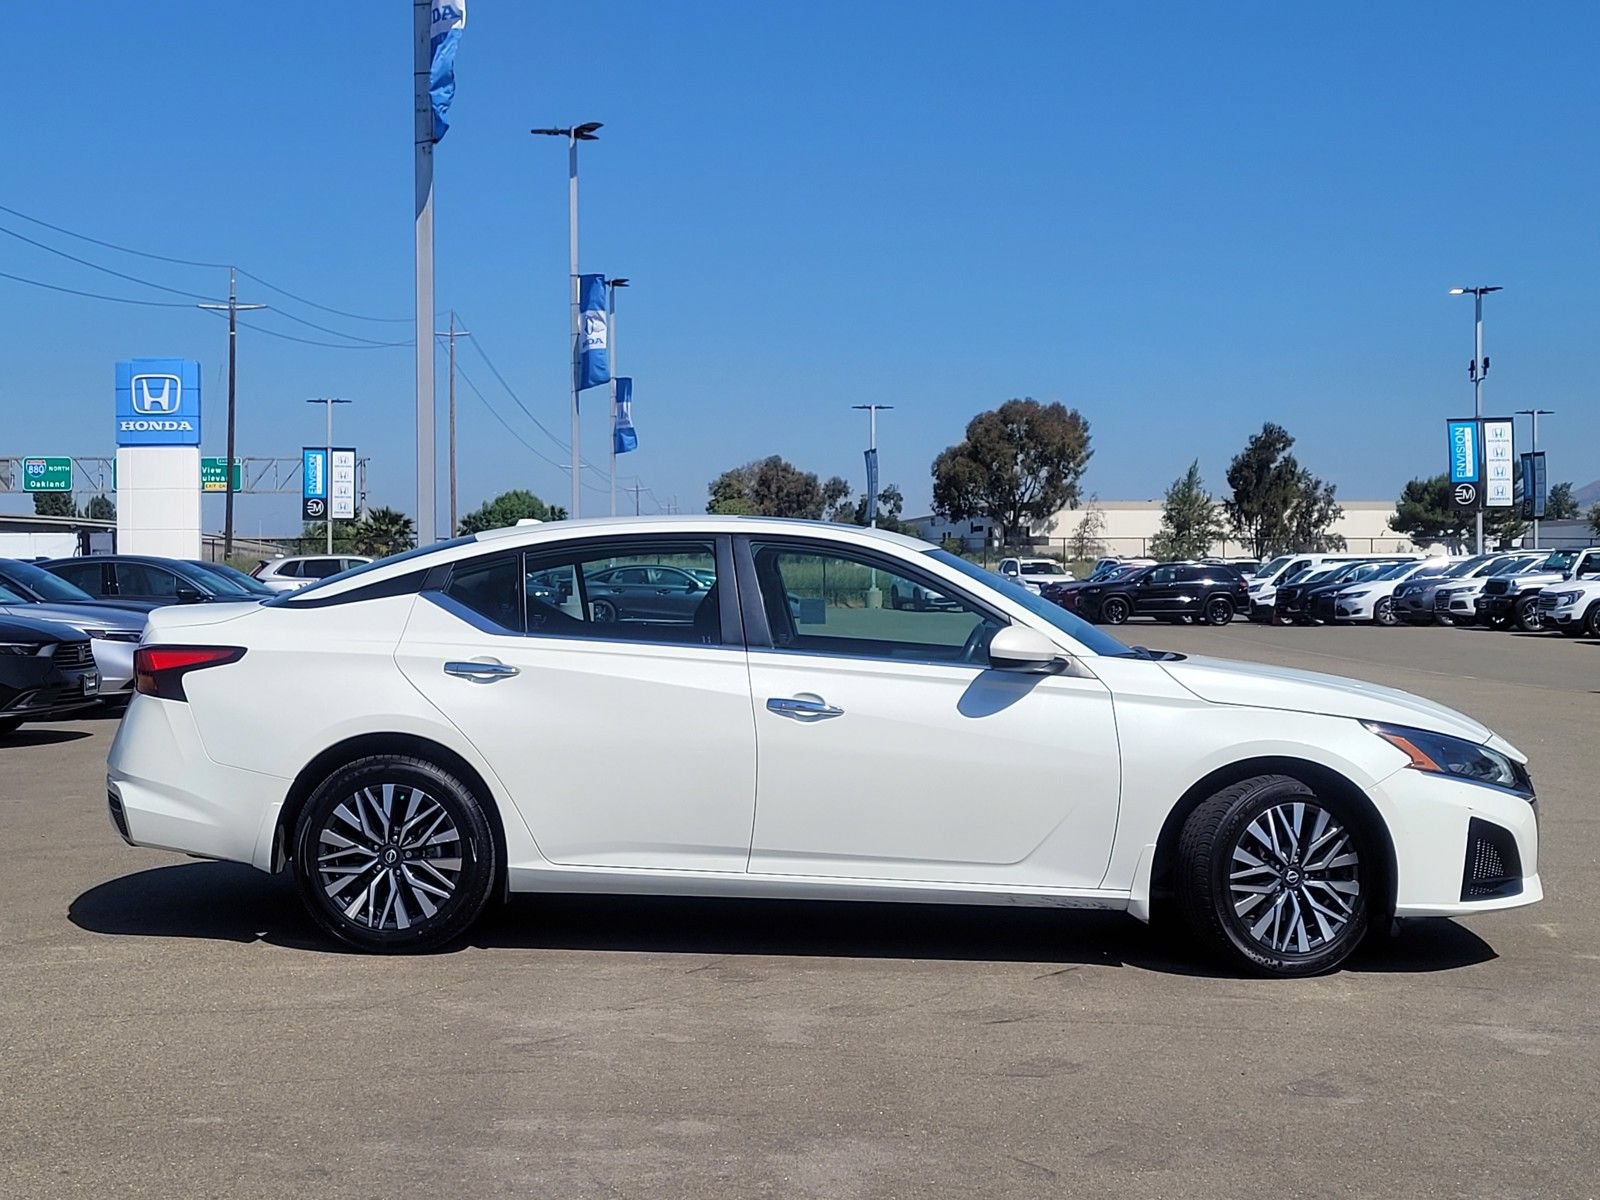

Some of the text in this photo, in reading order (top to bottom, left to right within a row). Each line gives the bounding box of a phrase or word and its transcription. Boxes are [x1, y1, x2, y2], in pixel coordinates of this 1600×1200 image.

[120, 421, 193, 431] HONDA
[1455, 427, 1466, 478] ENVISION
[28, 465, 45, 474] 880
[30, 480, 65, 488] Oakland
